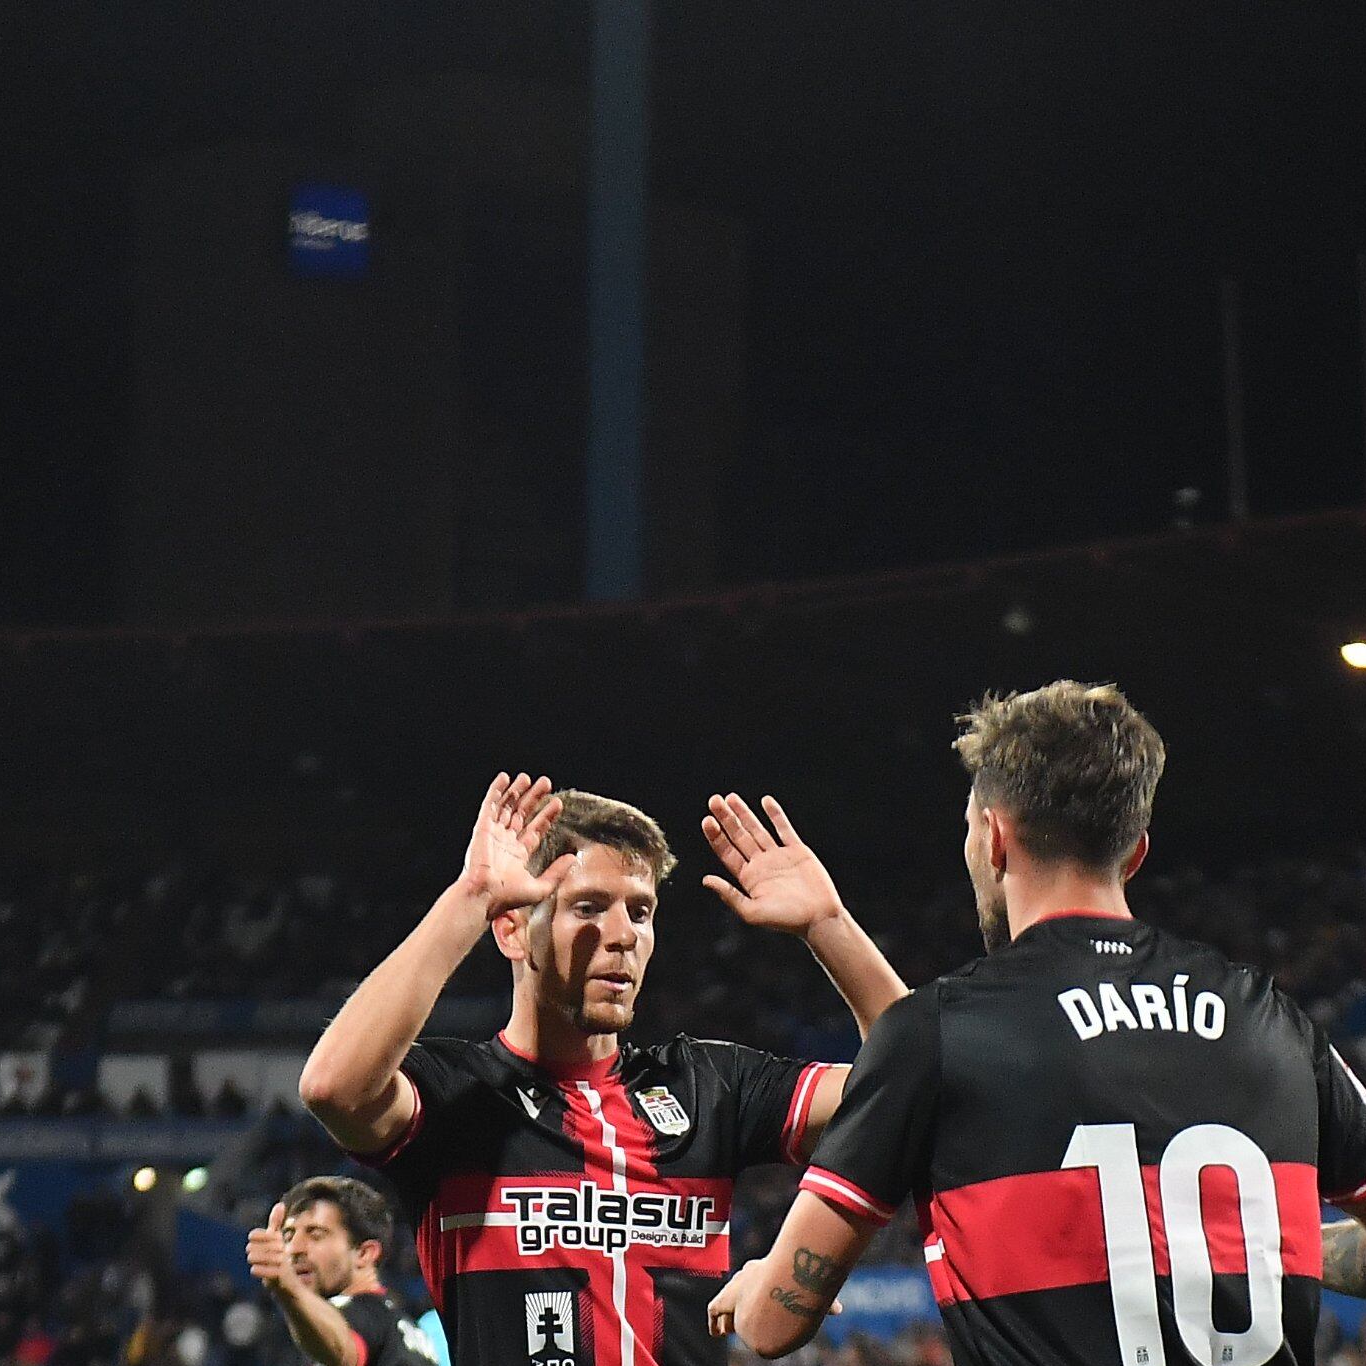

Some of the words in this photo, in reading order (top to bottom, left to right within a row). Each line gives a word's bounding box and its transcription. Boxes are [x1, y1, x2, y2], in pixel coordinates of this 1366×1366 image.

[1057, 973, 1226, 1041] DARÍO
[505, 1185, 714, 1230] Talasur
[520, 1225, 626, 1253] group
[631, 1230, 667, 1243] Design
[671, 1232, 679, 1243] &
[681, 1232, 703, 1244] Build
